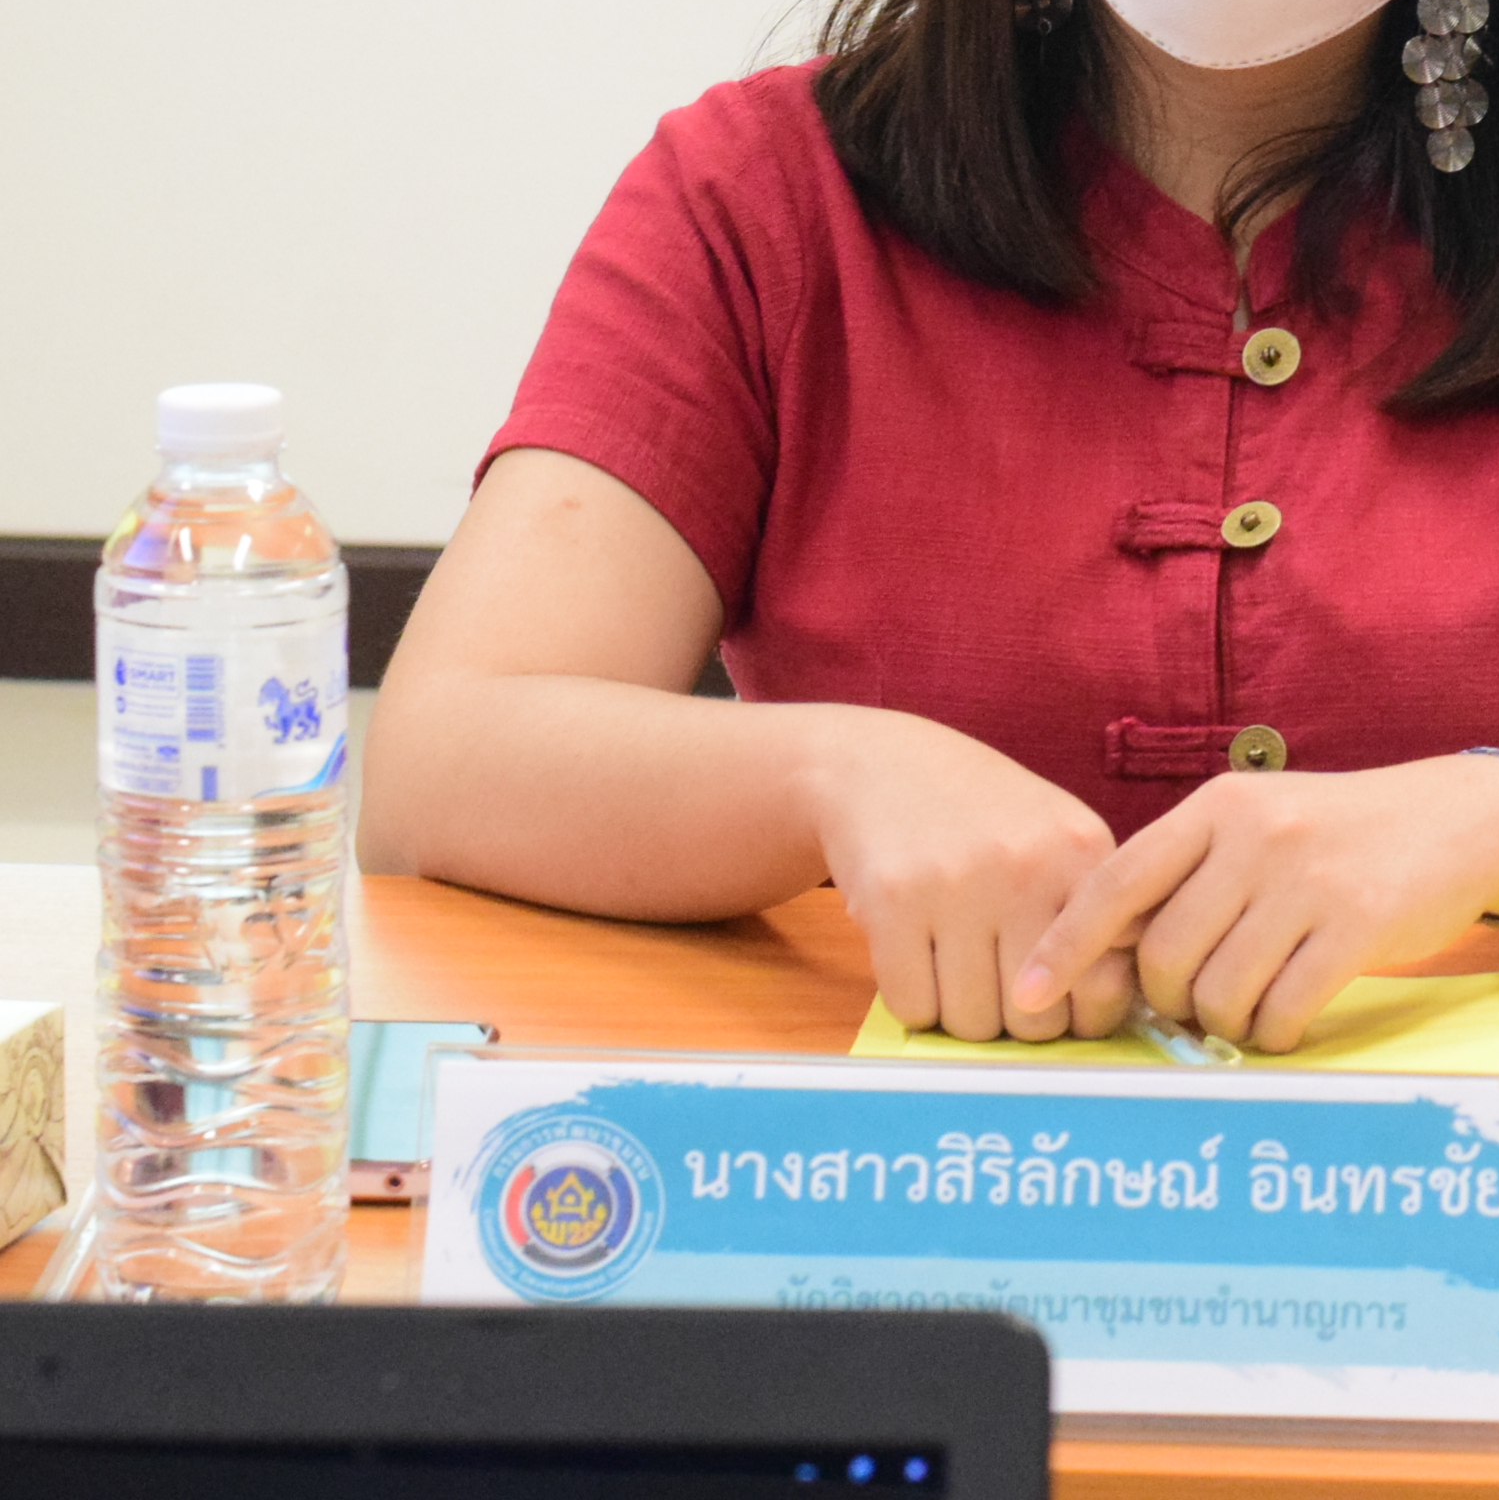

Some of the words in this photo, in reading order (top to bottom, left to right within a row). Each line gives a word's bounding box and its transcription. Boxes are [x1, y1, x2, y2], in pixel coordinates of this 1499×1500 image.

[684, 1130, 1225, 1211] นางสาวสิริลักษณ์
